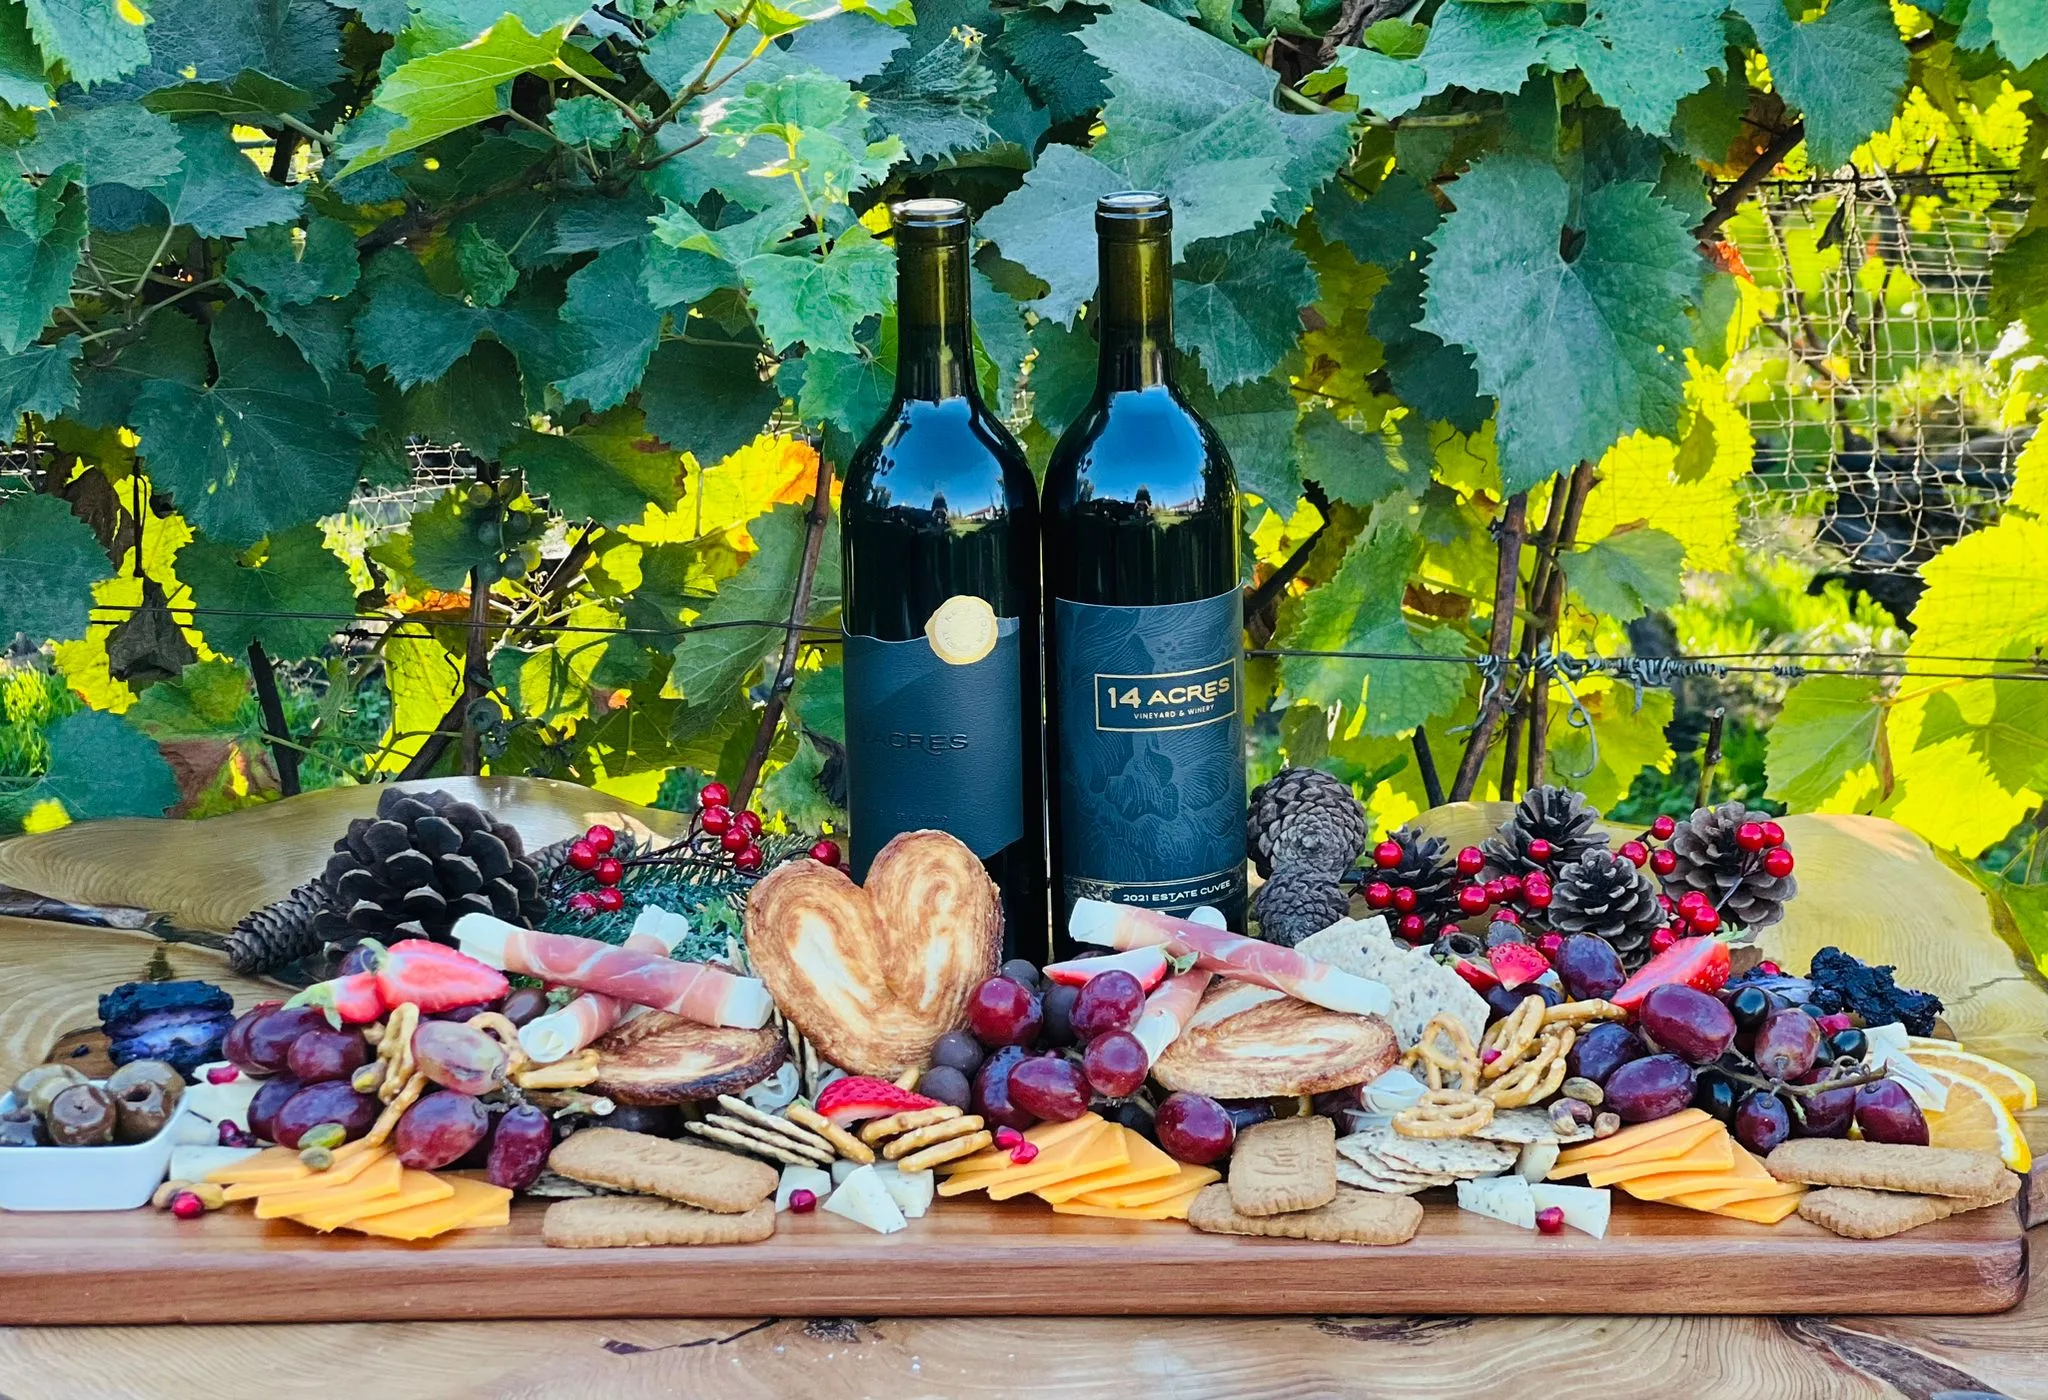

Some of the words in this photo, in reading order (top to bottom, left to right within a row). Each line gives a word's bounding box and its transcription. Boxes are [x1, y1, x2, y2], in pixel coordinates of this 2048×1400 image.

[1108, 687, 1141, 709] 14
[1147, 677, 1230, 705] ACRES
[1133, 710, 1176, 720] VINEYARD
[1179, 709, 1185, 717] &
[1187, 704, 1215, 715] WINERY
[1123, 893, 1149, 902] 2021
[1152, 889, 1198, 902] ESTATE
[1200, 879, 1231, 896] CUVEE
